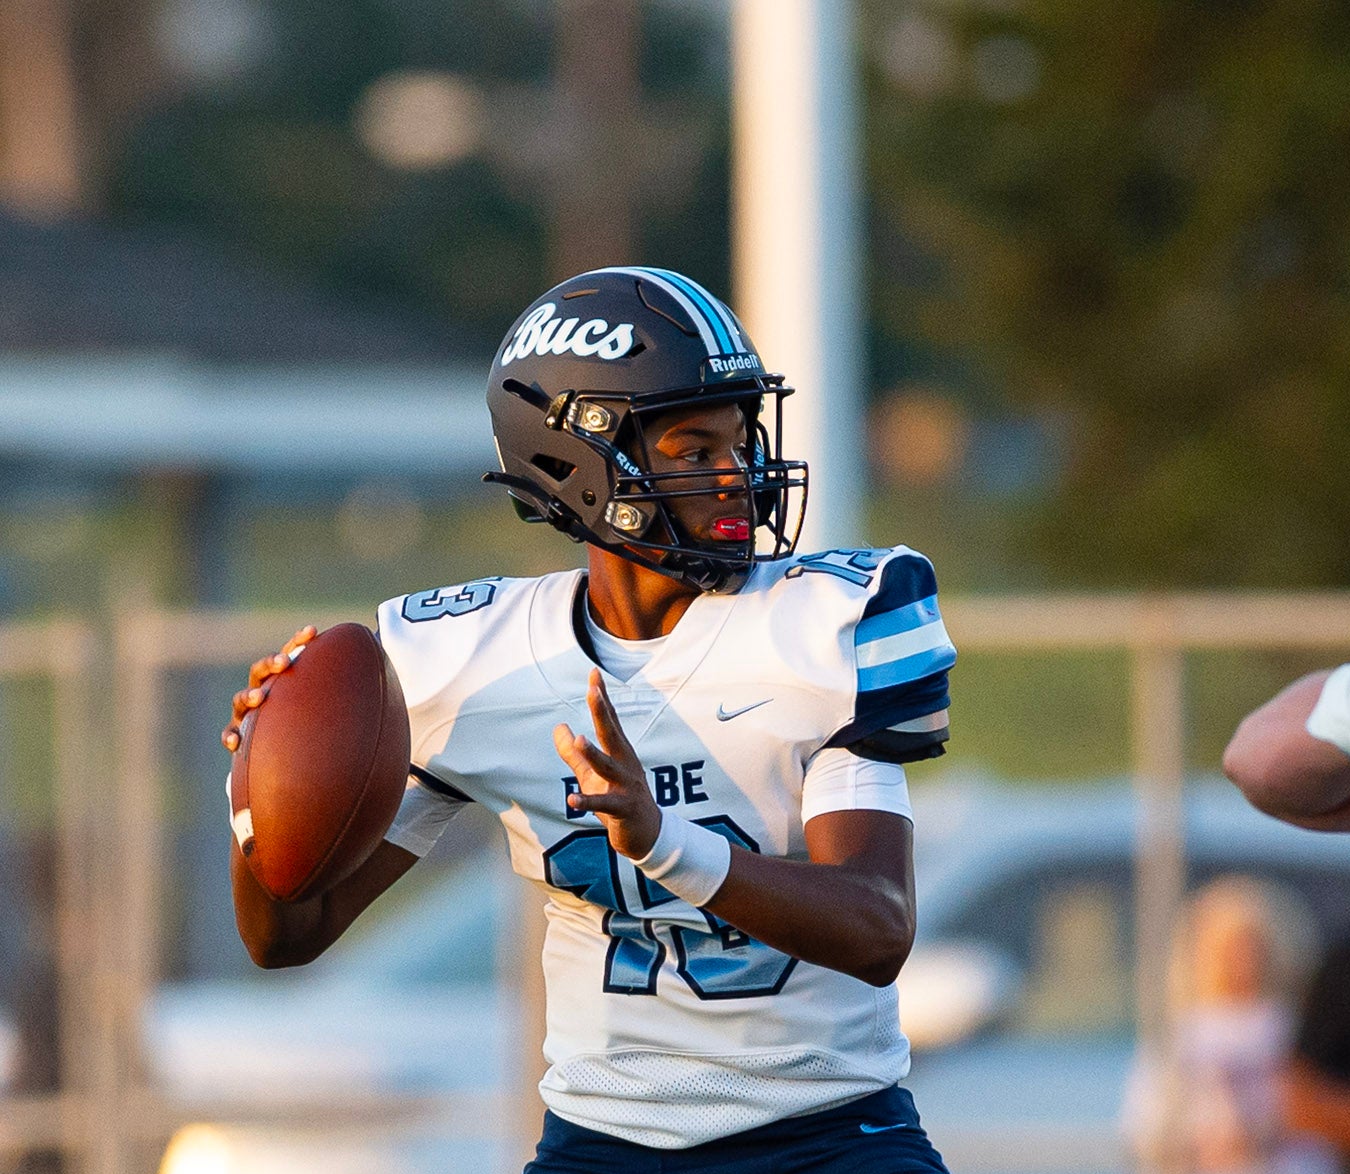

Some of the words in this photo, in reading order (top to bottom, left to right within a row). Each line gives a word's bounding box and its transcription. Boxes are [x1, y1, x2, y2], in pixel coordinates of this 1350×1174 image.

[502, 303, 634, 366] Bucs
[709, 354, 760, 373] Riddell
[561, 760, 709, 820] BBE
